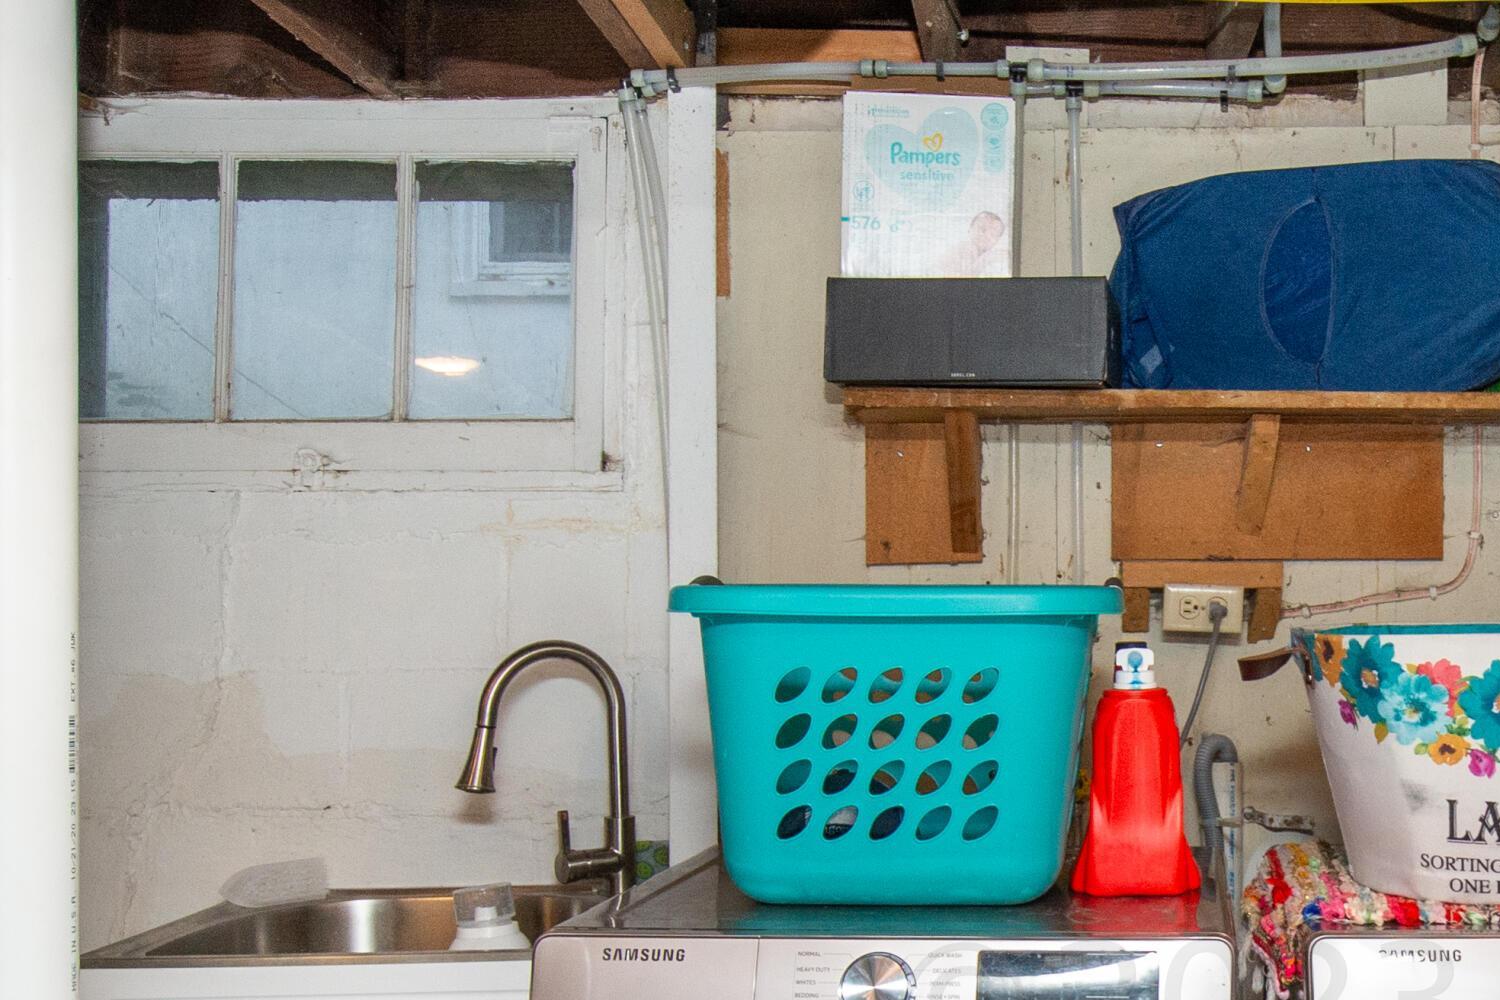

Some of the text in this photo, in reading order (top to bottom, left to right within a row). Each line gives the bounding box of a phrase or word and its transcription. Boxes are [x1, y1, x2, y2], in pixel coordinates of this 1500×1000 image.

[890, 142, 960, 167] Pampers
[899, 169, 955, 182] sensitive
[851, 216, 881, 230] 576
[1449, 879, 1491, 894] ONE
[602, 947, 686, 962] SAMSUNG
